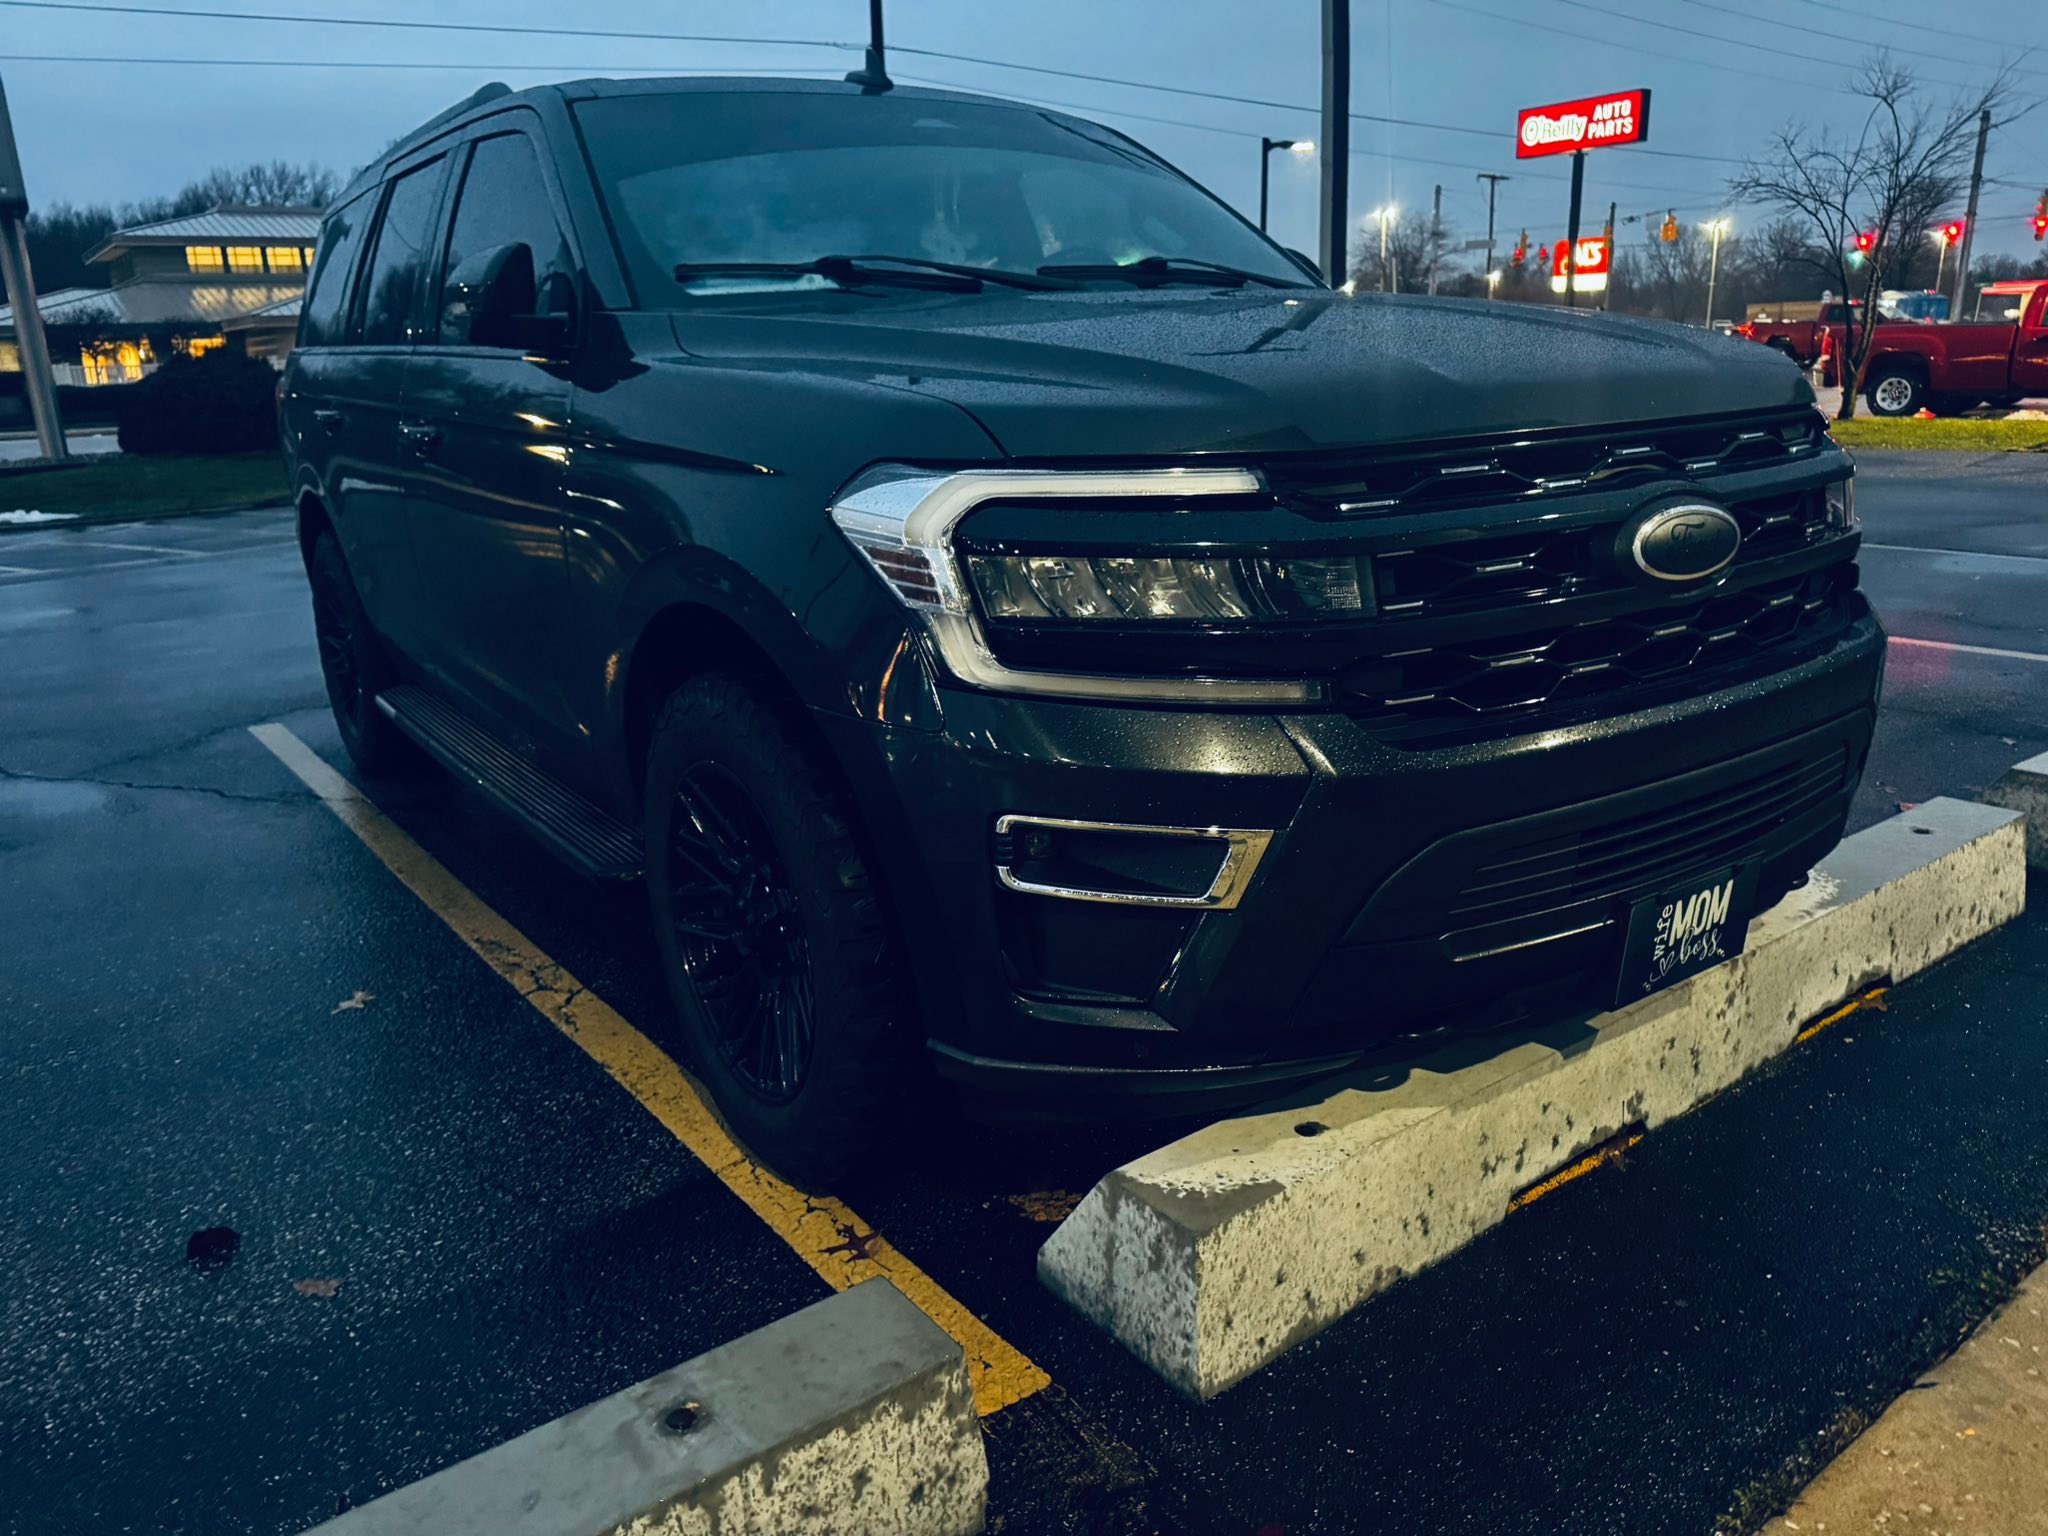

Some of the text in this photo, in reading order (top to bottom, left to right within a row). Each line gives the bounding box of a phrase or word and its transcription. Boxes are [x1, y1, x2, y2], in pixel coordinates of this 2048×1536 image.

[1587, 116, 1634, 140] PARTS
[1593, 99, 1632, 122] AUTO
[1521, 114, 1588, 147] O'Reilly
[1668, 879, 1734, 947] MOM
[1652, 904, 1674, 962] wife
[1679, 926, 1722, 965] boss
